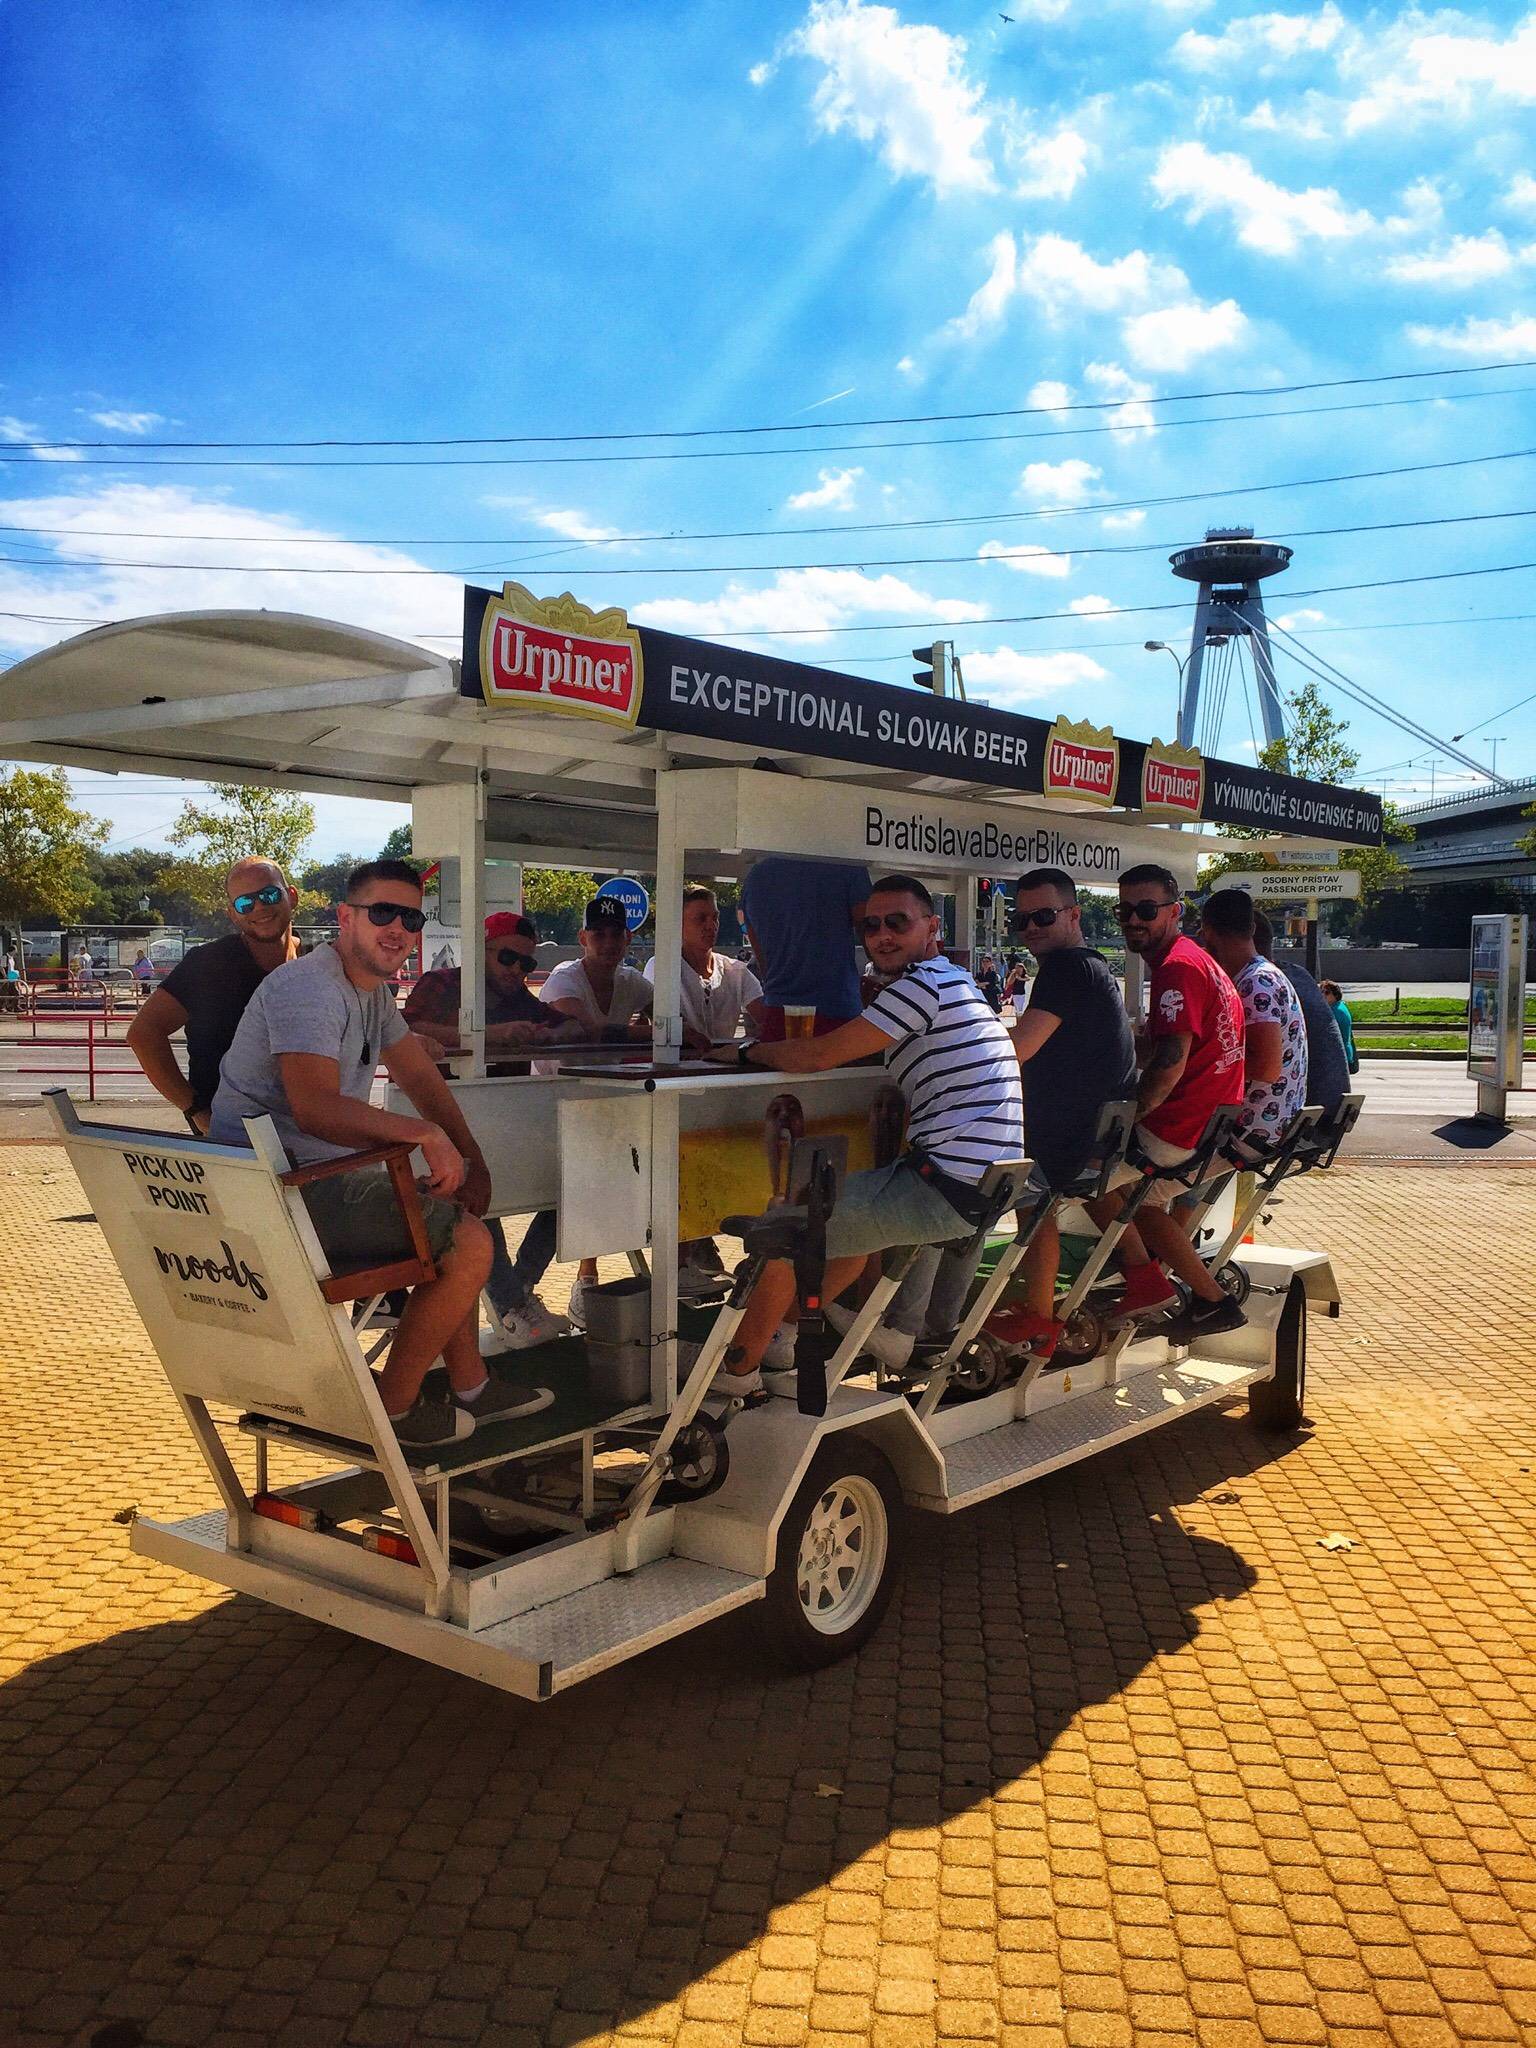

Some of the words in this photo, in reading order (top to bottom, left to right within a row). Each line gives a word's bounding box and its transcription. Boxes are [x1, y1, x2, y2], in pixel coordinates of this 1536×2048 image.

[499, 626, 627, 695] Urpiner
[669, 665, 870, 738] EXCEPTIONAL
[876, 709, 969, 757] SLOVAK
[973, 729, 1029, 767] BEER
[1052, 744, 1112, 787] Urpiner
[1149, 765, 1199, 802] Urpiner
[1214, 777, 1287, 817] VÝNIMOČNÉ
[1288, 804, 1355, 829] SLOVENSKÉ
[1355, 810, 1380, 834] PIVO
[865, 807, 1120, 871] BratislavaBeerBike.com
[1262, 885, 1316, 893] PASSENGER
[1318, 885, 1344, 893] PORT
[122, 1152, 177, 1181] PICK
[174, 1159, 205, 1184] UP
[147, 1184, 210, 1215] POINT
[153, 1240, 269, 1301] moods
